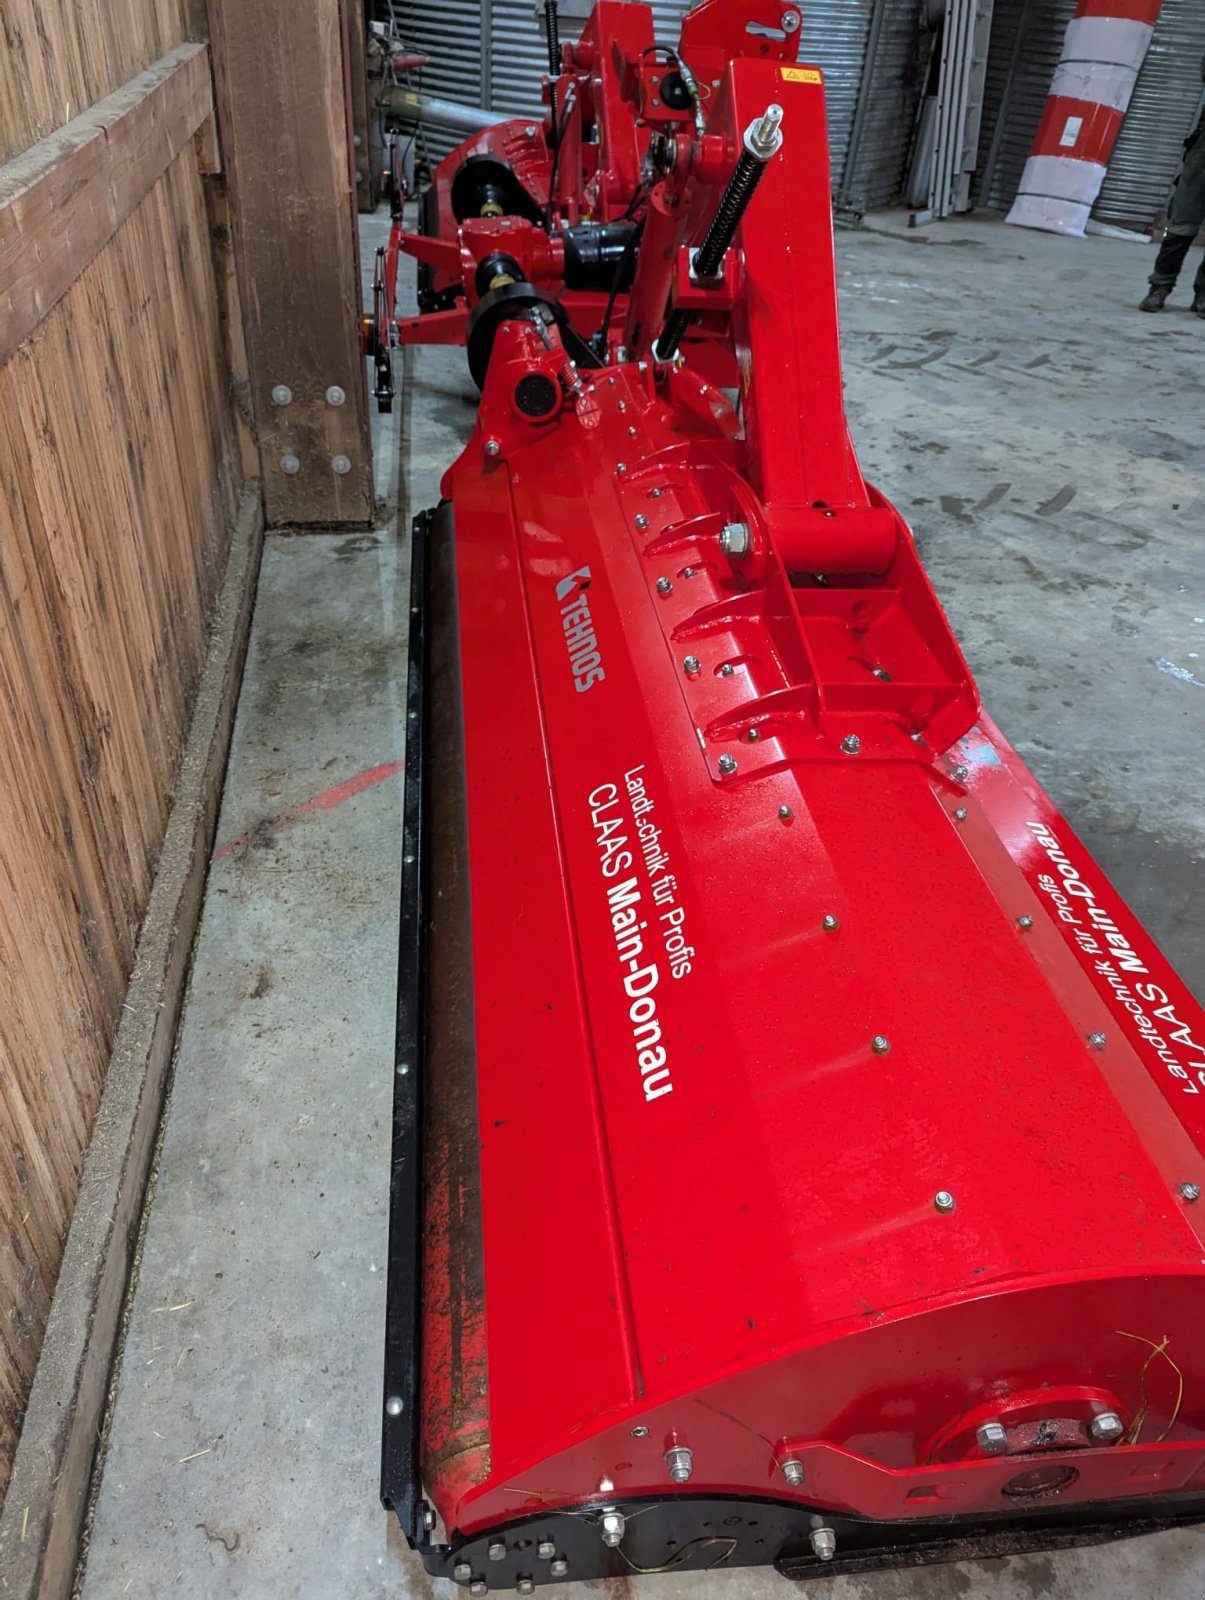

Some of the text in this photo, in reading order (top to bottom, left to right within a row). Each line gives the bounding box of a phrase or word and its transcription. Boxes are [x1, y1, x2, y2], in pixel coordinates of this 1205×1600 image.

[560, 593, 606, 693] TEHNOS
[588, 783, 673, 1103] CLAAS Main-Donau
[651, 874, 678, 906] für
[659, 906, 696, 980] Profis
[1026, 821, 1205, 1087] LAAS Main-Donau
[1037, 874, 1199, 1094] Landtechnik für Profis
